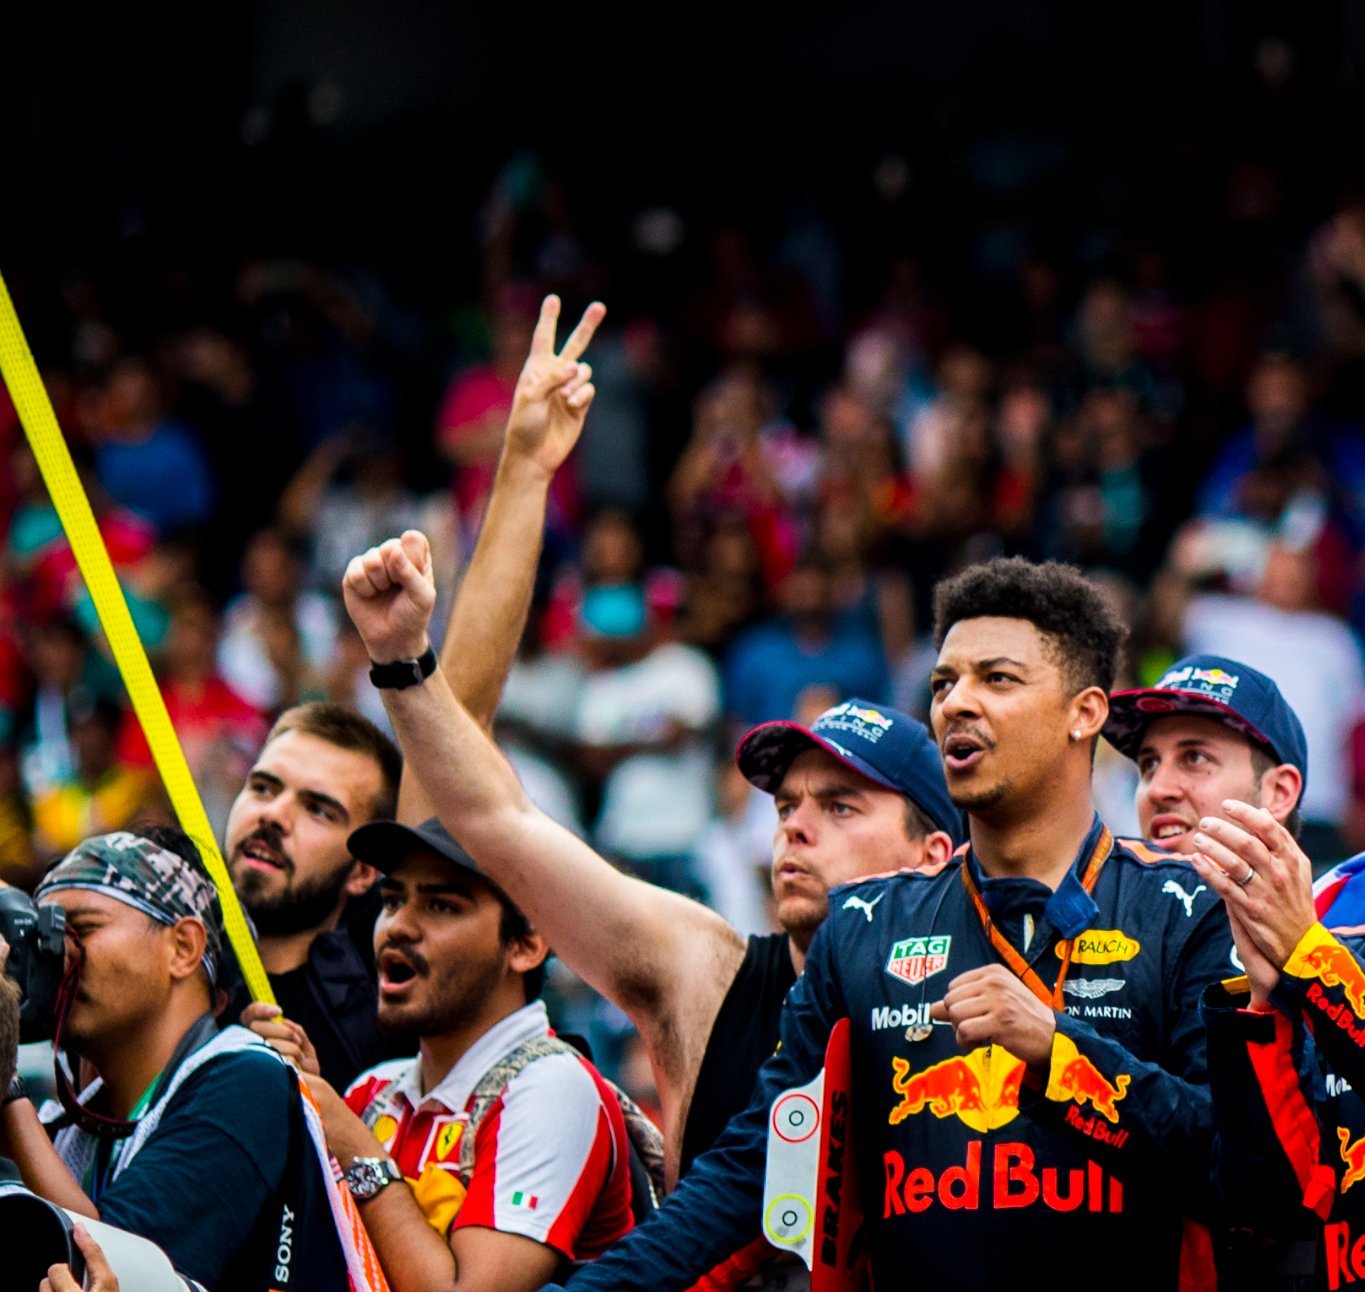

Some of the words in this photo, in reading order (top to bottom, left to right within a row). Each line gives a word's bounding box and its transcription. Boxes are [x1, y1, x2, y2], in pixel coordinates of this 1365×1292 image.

[899, 938, 945, 955] TAG
[1077, 939, 1128, 955] RAUCH
[890, 956, 944, 984] HEUER
[871, 1003, 931, 1031] Mobil
[1084, 1006, 1132, 1020] MARTIN
[1306, 982, 1341, 1020] Red
[1064, 1103, 1094, 1136] Red
[1093, 1119, 1129, 1149] Bull
[821, 1089, 848, 1269] BRAKES
[883, 1140, 982, 1220] Red
[993, 1142, 1124, 1214] Bull
[275, 1203, 295, 1284] SONY
